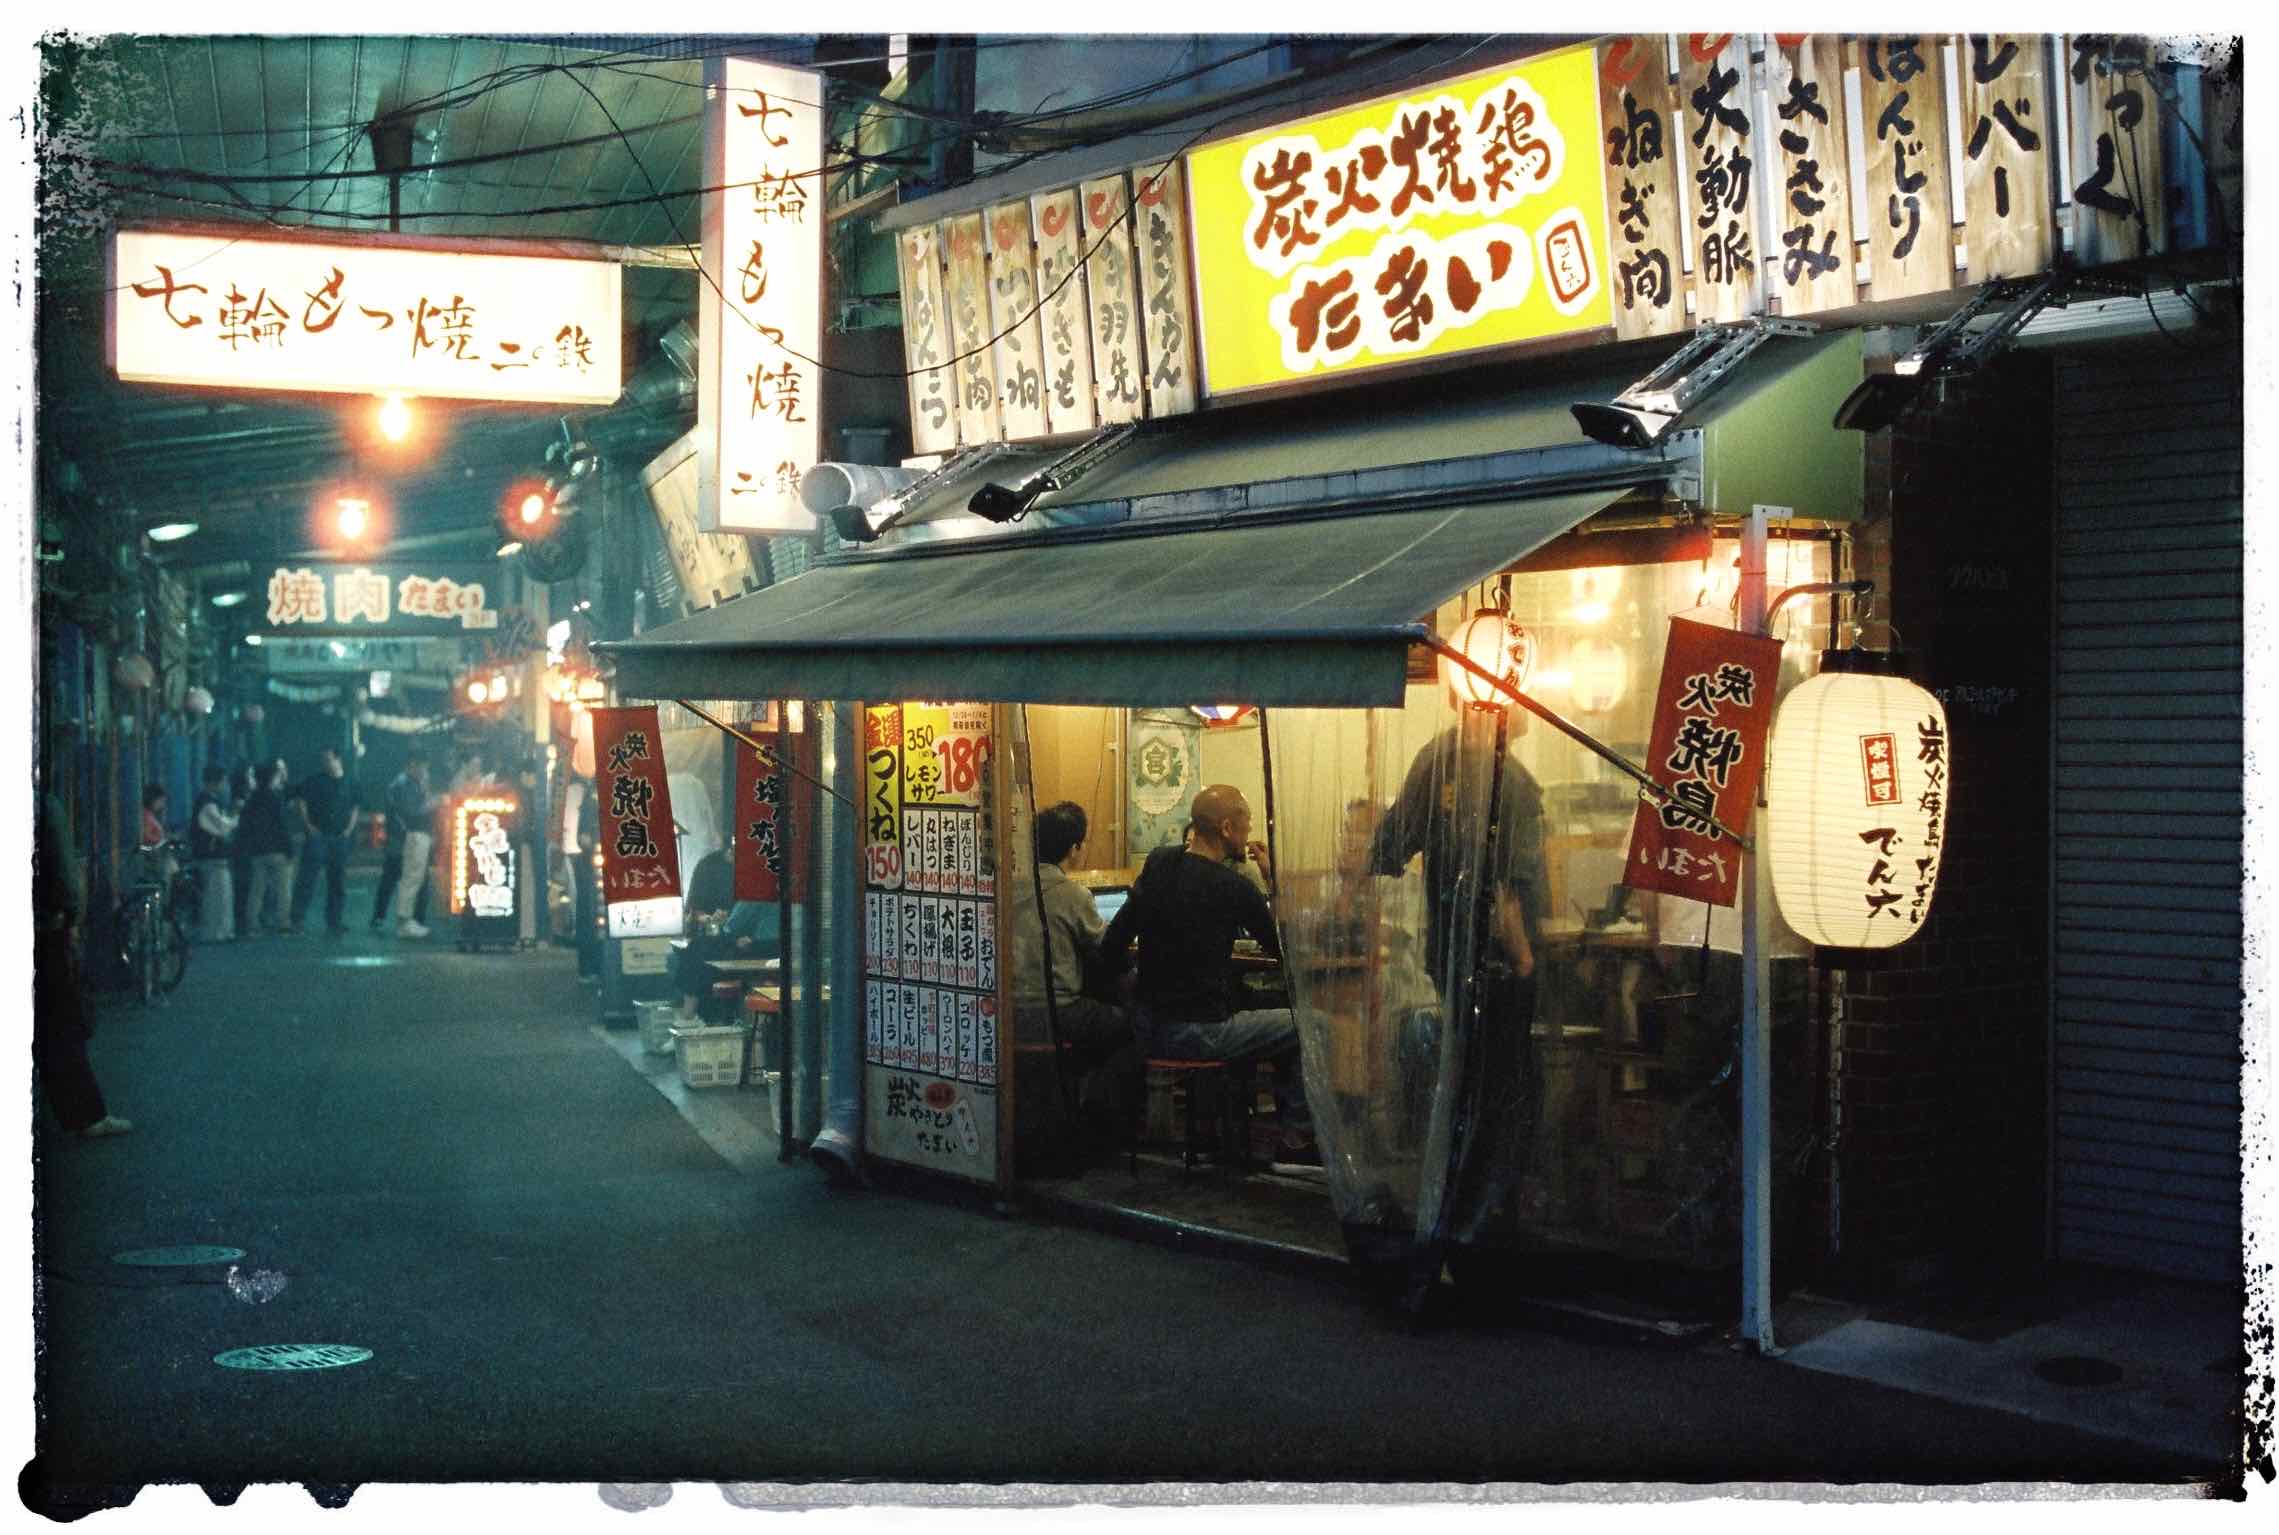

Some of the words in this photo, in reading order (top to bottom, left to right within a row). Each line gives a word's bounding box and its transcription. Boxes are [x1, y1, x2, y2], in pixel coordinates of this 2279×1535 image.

[1251, 87, 1553, 257] 炭火焼鶏
[1608, 94, 1671, 309] ねぎ間
[1693, 60, 1754, 286] 大動脈
[1778, 77, 1840, 285] ささみ
[131, 263, 481, 362] 七輪もつ焼
[996, 268, 1040, 410] つくね
[1099, 239, 1139, 404] 手羽先
[1290, 240, 1512, 355] たまい
[270, 570, 389, 623] 焼肉
[399, 576, 485, 618] たまい
[907, 725, 935, 752] 350
[869, 749, 897, 842] つくね
[906, 815, 921, 867] レバー
[943, 816, 957, 871] ねぎま
[866, 846, 902, 882] 150
[1858, 827, 1903, 920] でん六
[903, 903, 919, 957] ちくわ
